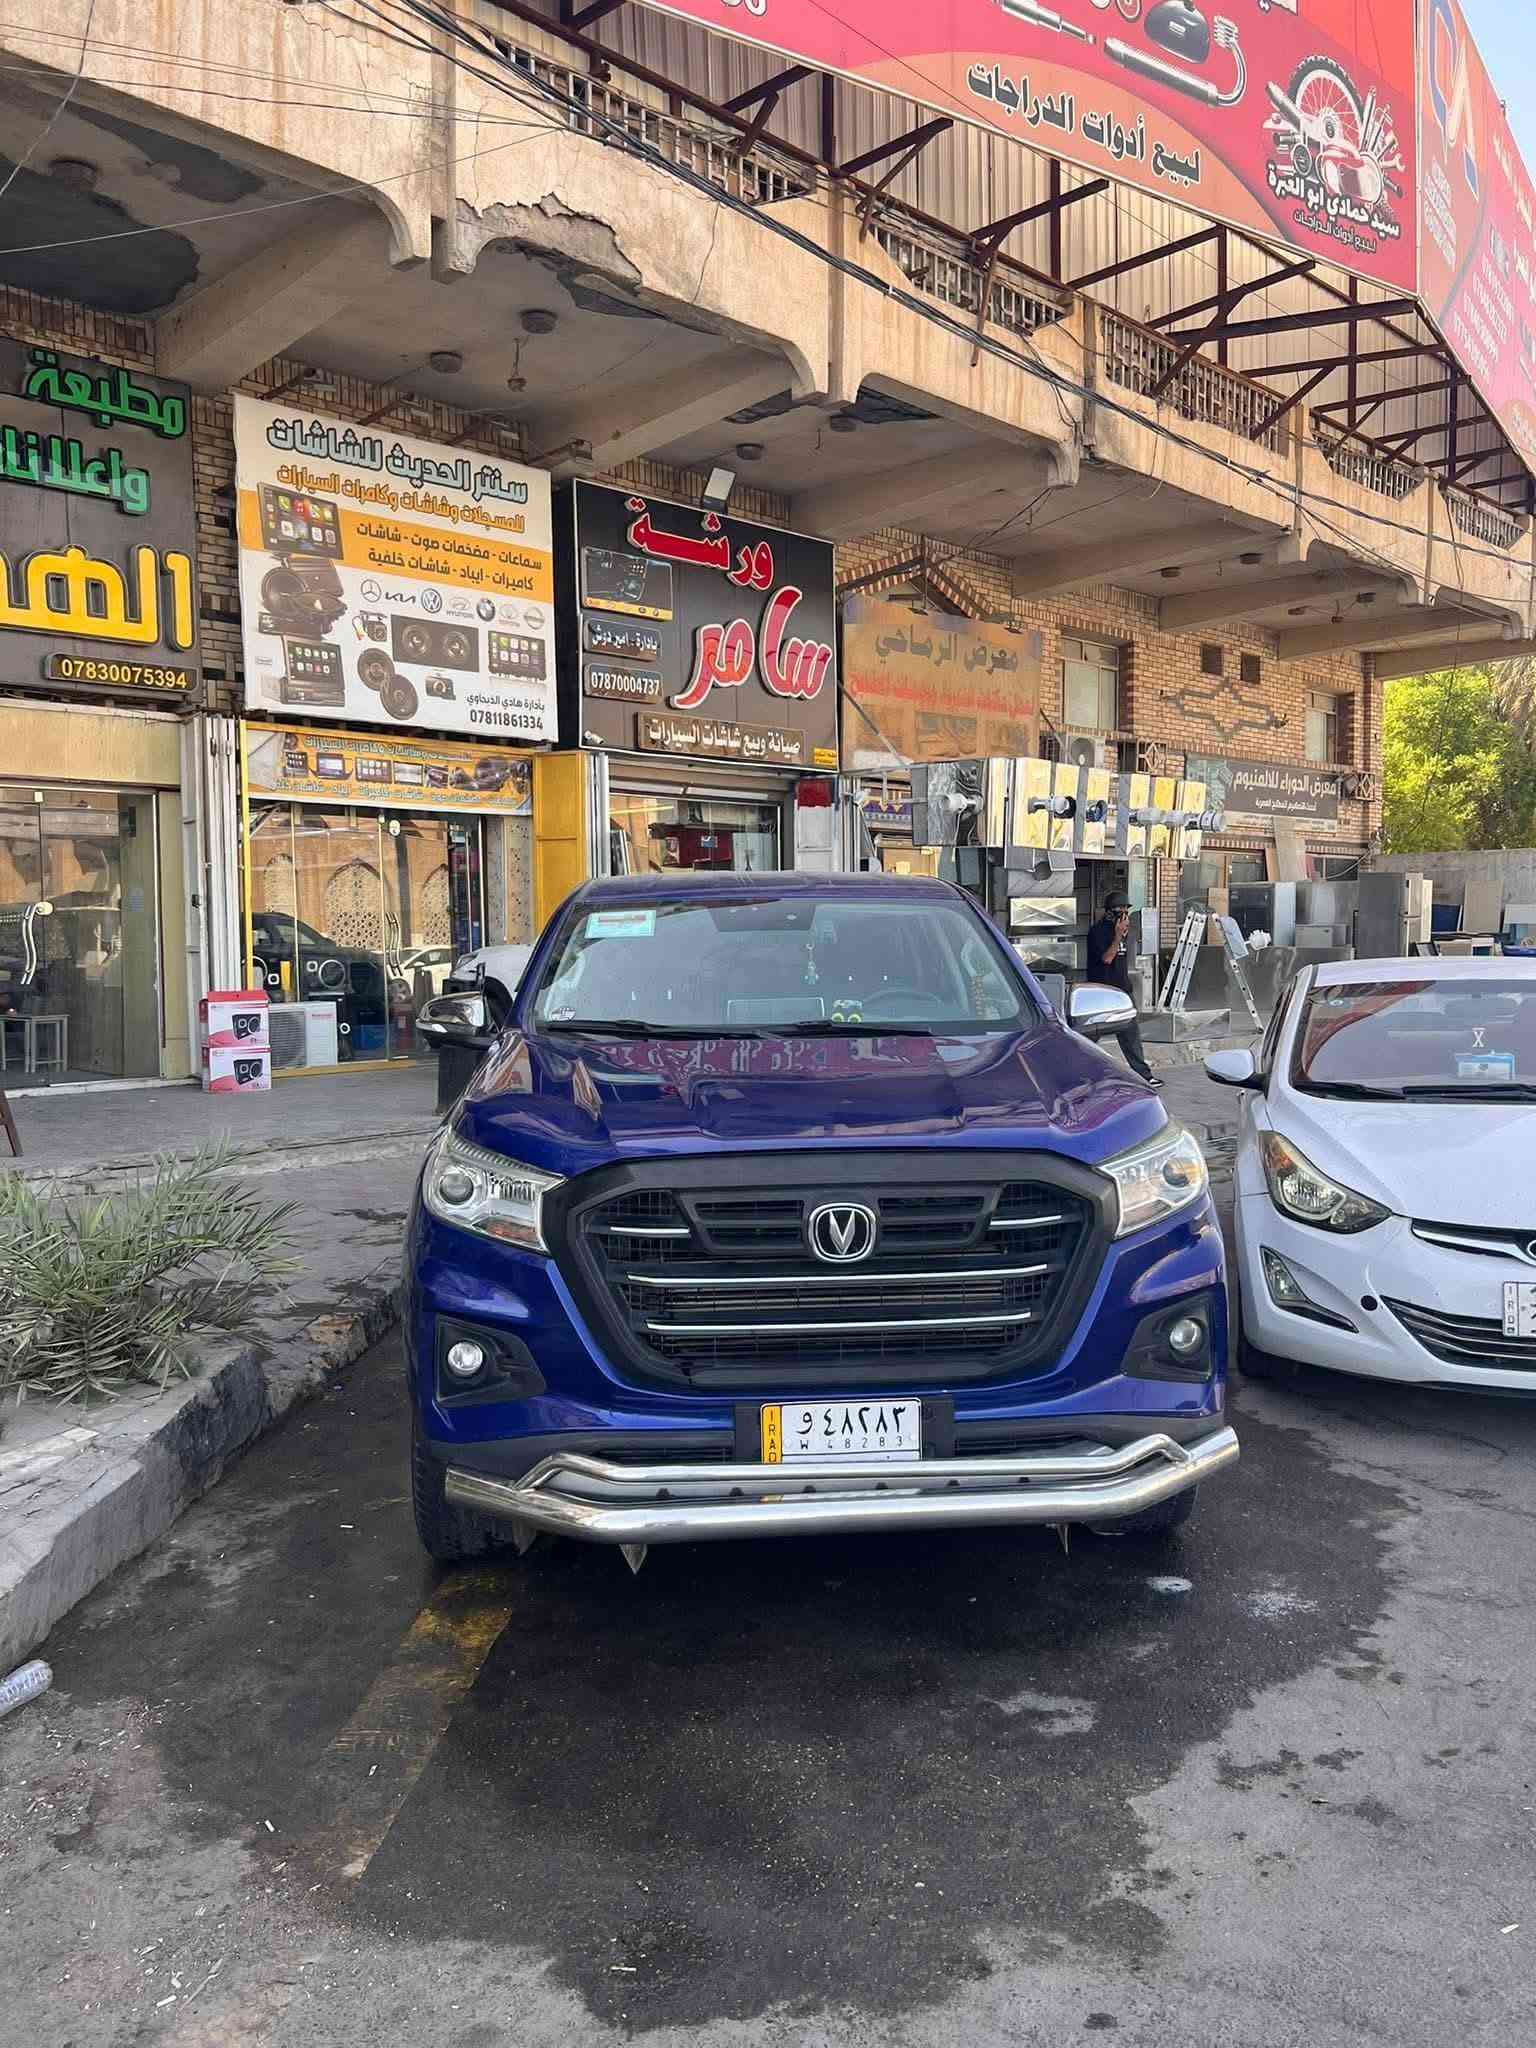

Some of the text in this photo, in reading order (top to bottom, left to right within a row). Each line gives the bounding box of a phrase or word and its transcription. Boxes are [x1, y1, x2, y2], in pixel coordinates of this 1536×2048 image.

[967, 64, 1200, 186] لبيع أدوات الدراجات
[1307, 186, 1324, 210] ابو
[1327, 196, 1370, 223] حمادي
[1371, 213, 1400, 239] سيد
[28, 350, 186, 437] مطبعة
[266, 418, 529, 504] سنتر الحديث للشاشات
[277, 465, 340, 494] السيارات
[400, 491, 459, 525] وشاشات
[356, 521, 402, 543] شاشات
[410, 533, 440, 552] صوت
[627, 496, 774, 590] ورشة
[367, 547, 405, 568] خلفية
[442, 540, 490, 561] مضخمات
[498, 550, 543, 571] سماعات
[407, 555, 451, 576] شاشات
[459, 565, 484, 584] ايباد
[492, 571, 534, 592] كاميرات
[0, 546, 194, 650] اله
[673, 585, 832, 710] سامر
[61, 657, 188, 689] 07830075394
[591, 671, 660, 695] 07870004737
[469, 709, 544, 730] 07811861334
[649, 719, 700, 747] السيارات
[702, 725, 741, 748] شاشات
[743, 731, 766, 756] وبيع
[767, 729, 800, 758] صيانة
[1280, 772, 1309, 795] الحوراء
[1310, 776, 1337, 797] معرض
